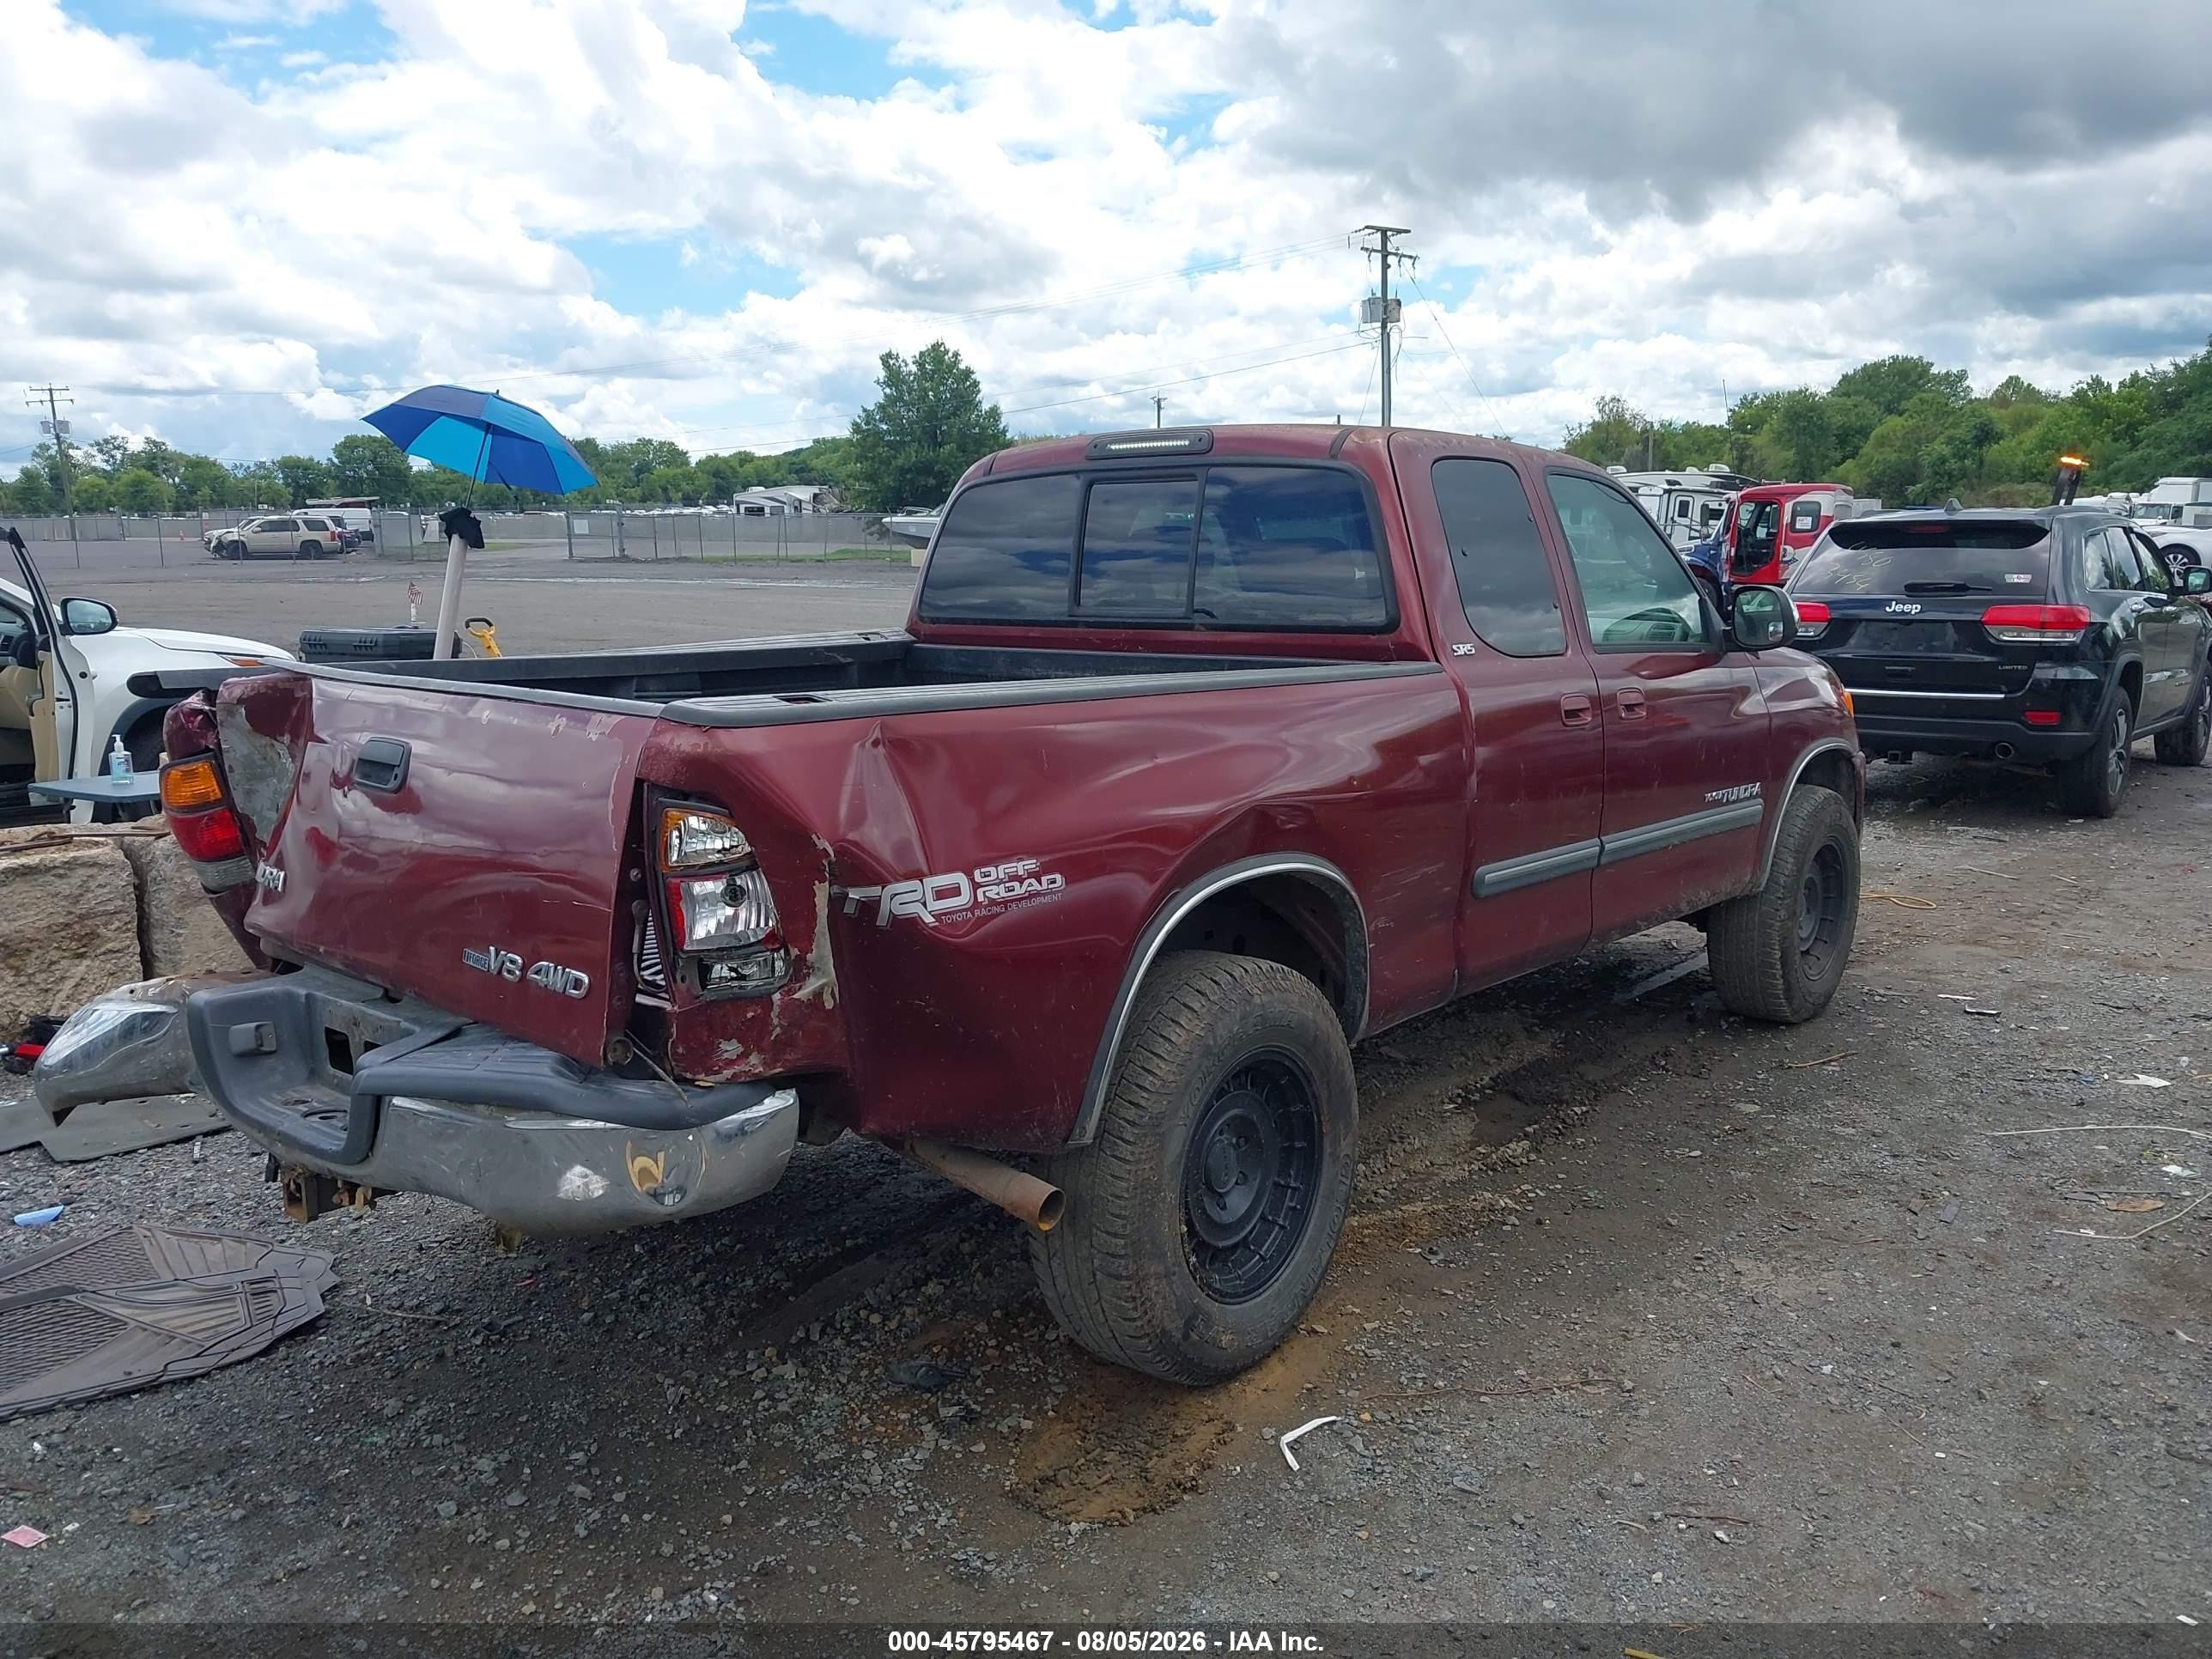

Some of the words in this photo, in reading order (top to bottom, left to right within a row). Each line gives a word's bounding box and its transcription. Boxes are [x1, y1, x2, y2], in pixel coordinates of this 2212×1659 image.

[1885, 600, 1922, 615] Jeep
[974, 859, 1039, 883] OFF
[842, 872, 972, 927] TRD
[976, 873, 1064, 903] ROAD
[940, 912, 974, 925] TOYOTA
[975, 905, 1006, 918] RACING
[1006, 892, 1063, 911] DEVELOPMENT
[489, 945, 524, 983] V8
[526, 961, 590, 1000] 4WD
